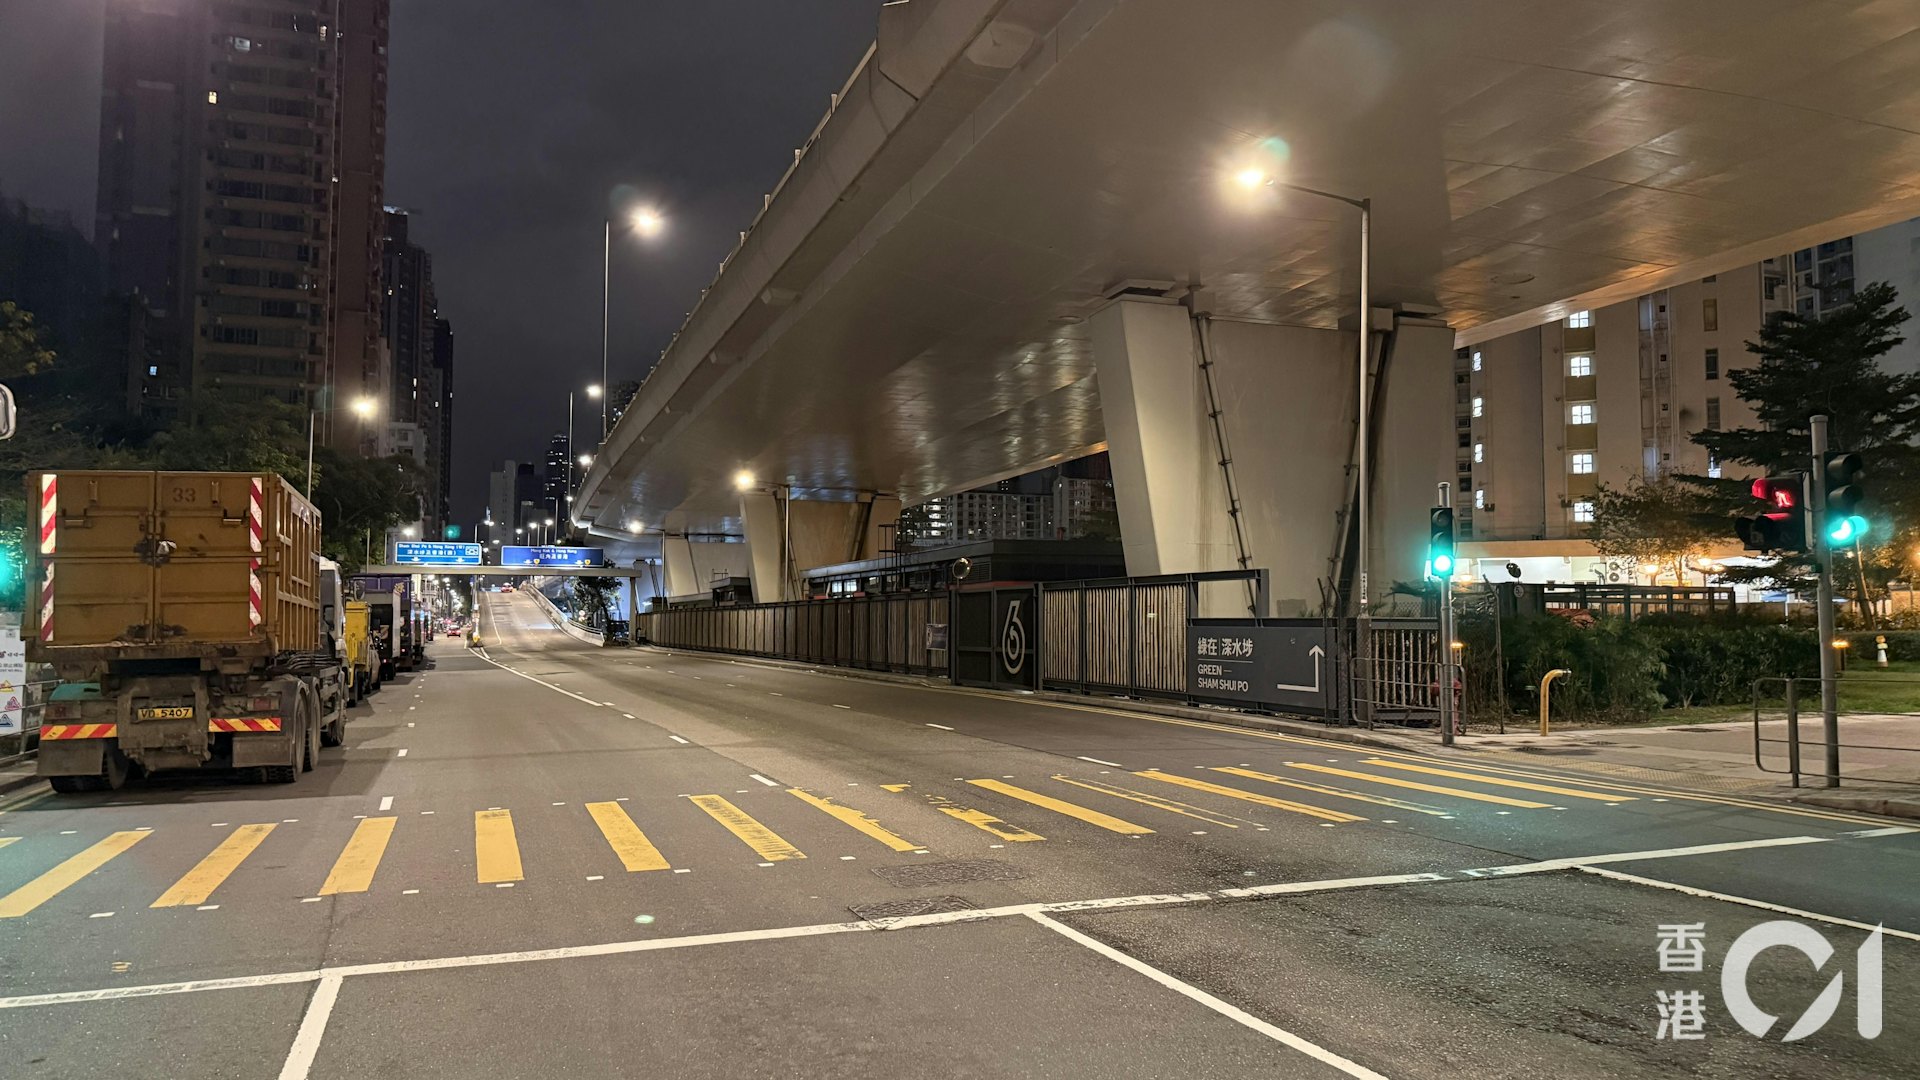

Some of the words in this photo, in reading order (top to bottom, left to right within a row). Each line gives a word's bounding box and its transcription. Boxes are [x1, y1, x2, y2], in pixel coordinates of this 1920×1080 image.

[172, 487, 196, 502] 33
[1221, 638, 1254, 657] 深水埗
[1197, 664, 1222, 676] GREEN
[1197, 677, 1218, 690] SHAM
[1219, 679, 1237, 691] SHUI
[1237, 680, 1249, 692] PO
[161, 708, 190, 718] 5407
